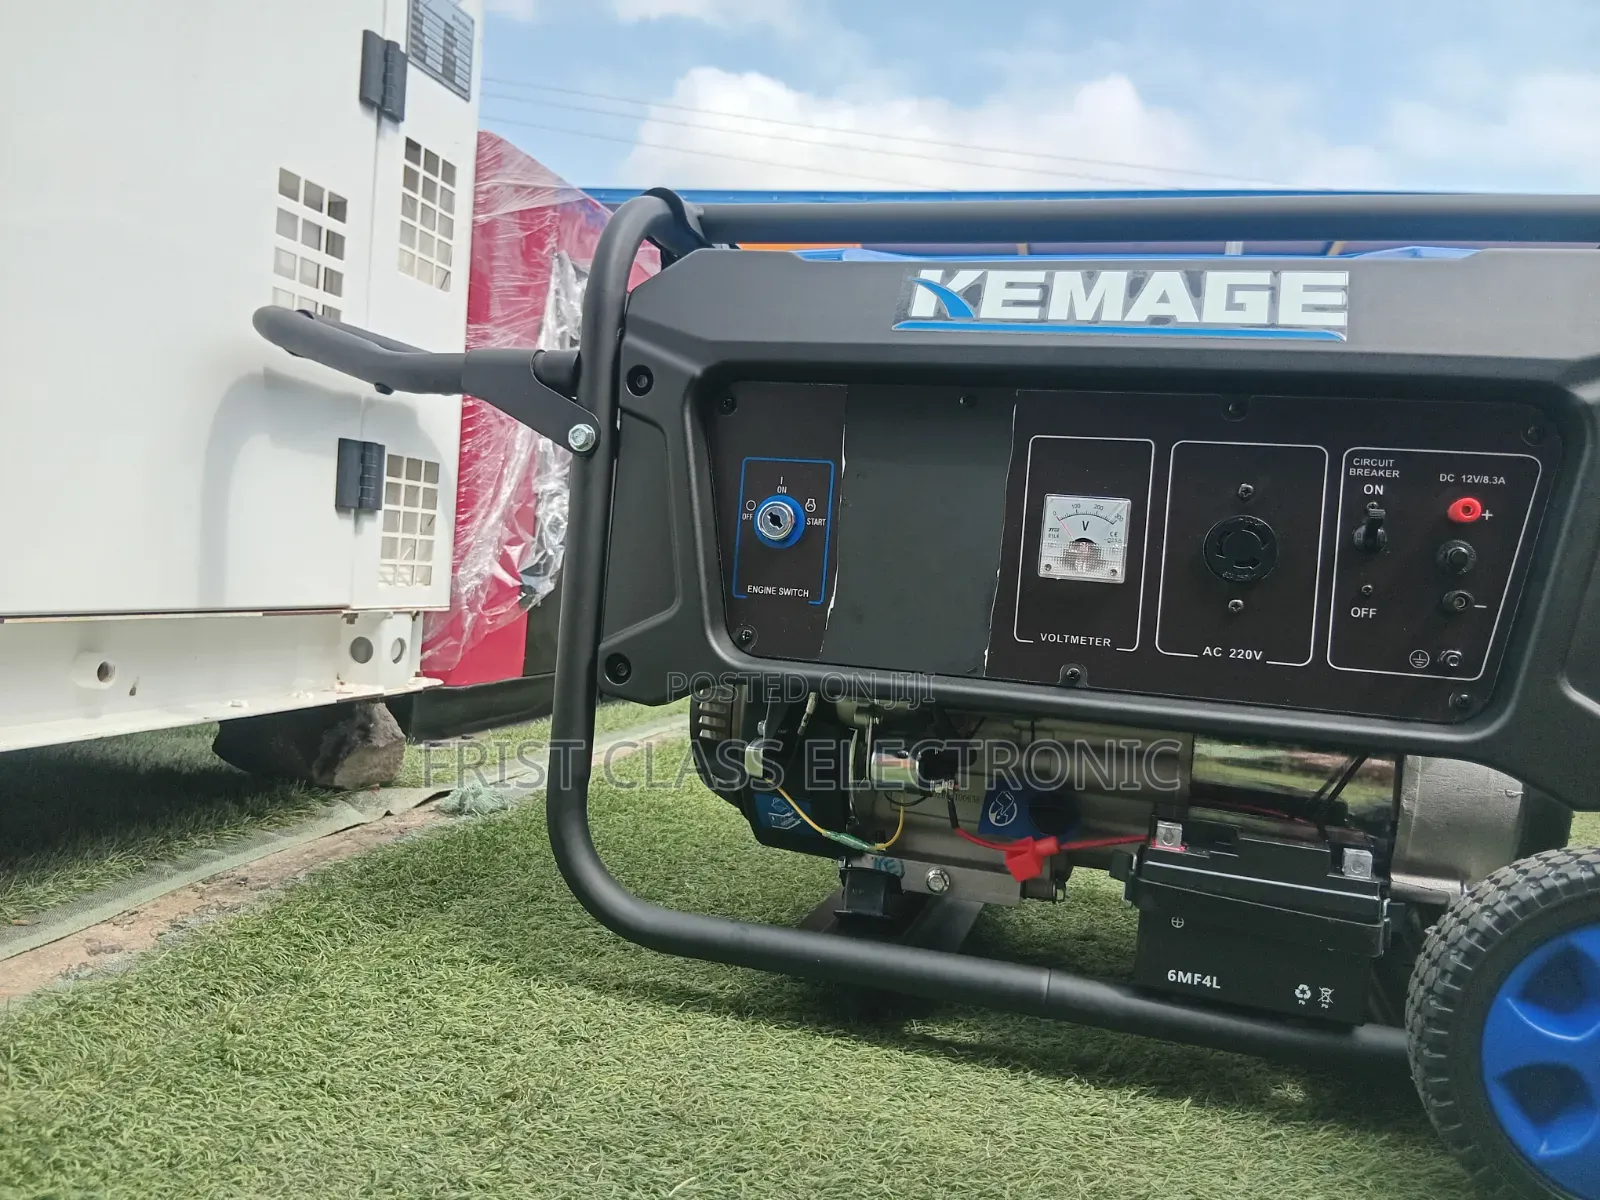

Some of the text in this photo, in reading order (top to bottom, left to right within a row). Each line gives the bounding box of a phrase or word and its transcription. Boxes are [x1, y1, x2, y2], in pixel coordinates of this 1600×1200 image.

[908, 268, 1349, 327] KEMAGE
[1352, 457, 1395, 468] CIRCUIT
[1349, 467, 1400, 478] BREAKER
[1439, 473, 1506, 485] DC 12V/8.3A
[777, 485, 787, 494] ON
[1363, 483, 1384, 496] ON
[806, 517, 827, 526] START
[1081, 520, 1090, 532] V
[747, 585, 809, 597] ENGINE SWITCH
[1350, 606, 1377, 619] OFF
[1039, 632, 1112, 648] VOLTMETER
[1202, 646, 1263, 661] AC 220V
[1166, 968, 1221, 989] 6MF4L
